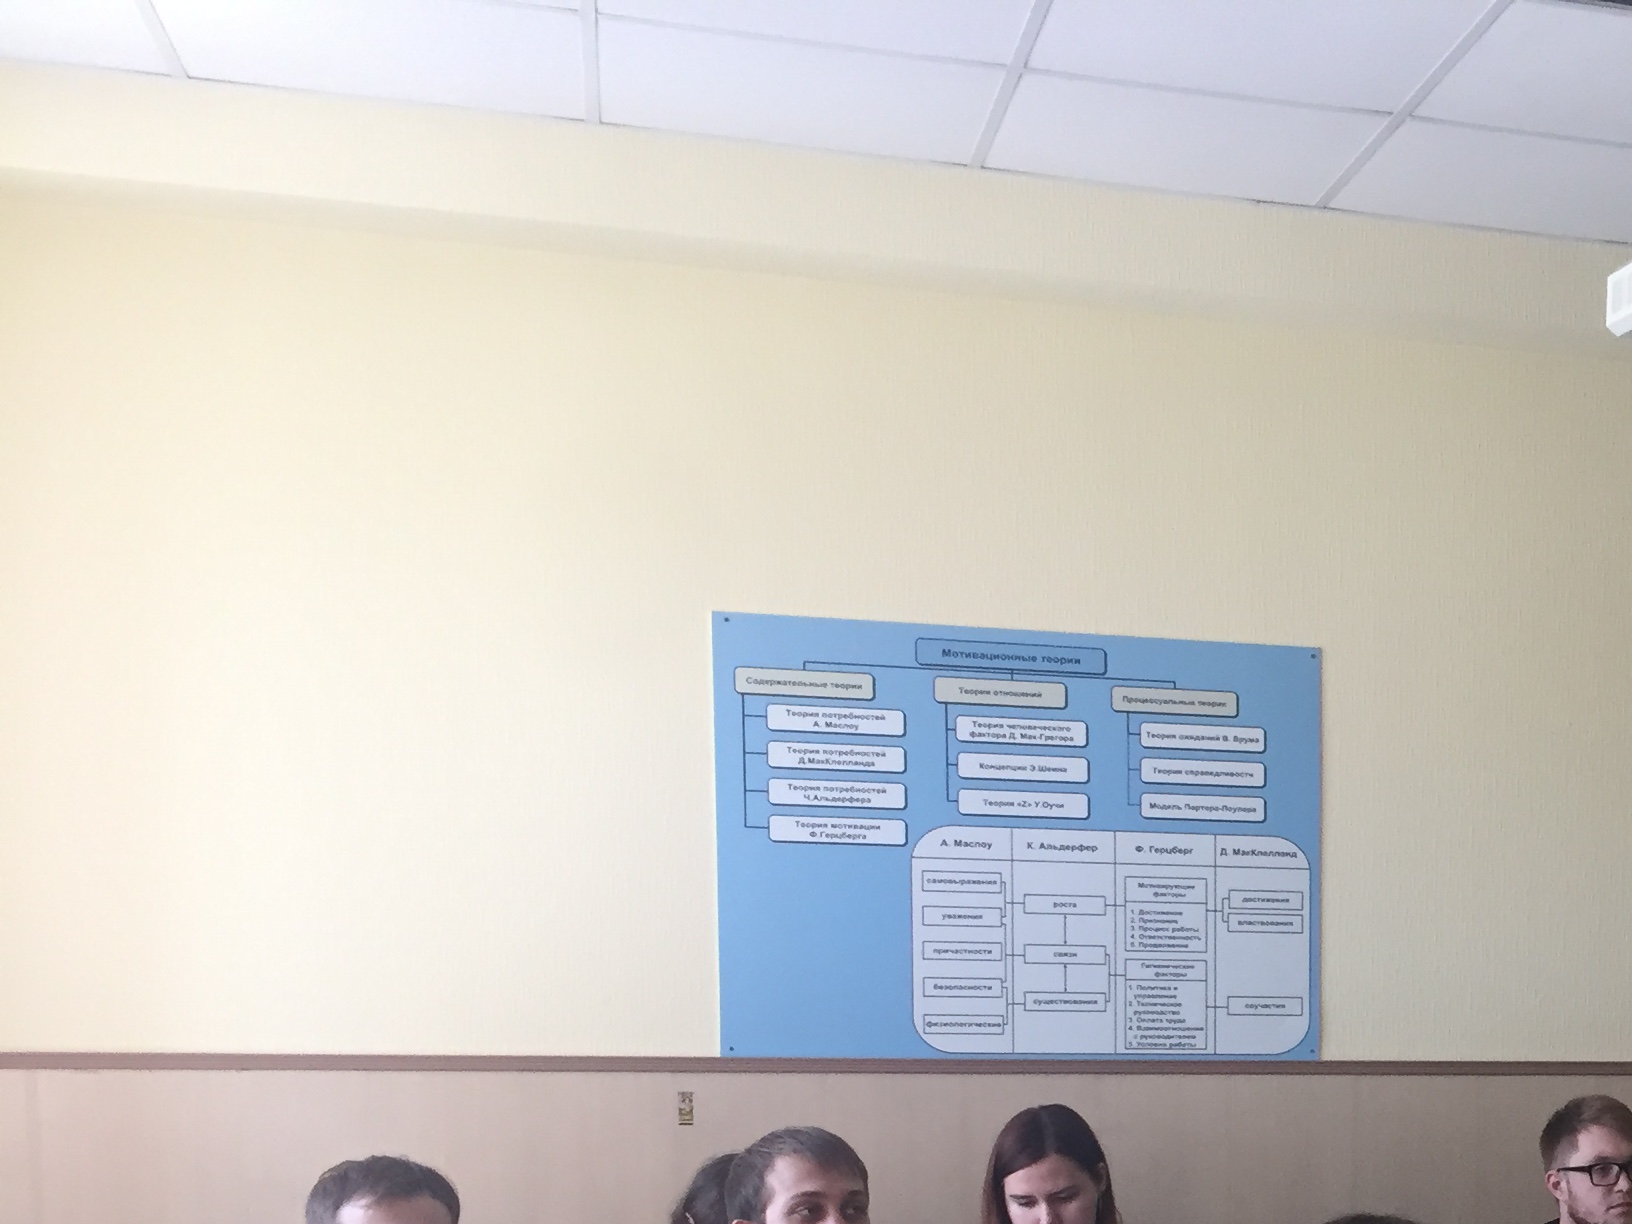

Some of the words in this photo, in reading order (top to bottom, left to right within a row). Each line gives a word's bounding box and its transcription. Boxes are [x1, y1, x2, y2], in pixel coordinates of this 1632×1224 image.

[942, 648, 1037, 664] Мотивационные
[1041, 655, 1081, 666] теории
[745, 676, 828, 689] Содержательные
[830, 682, 863, 692] теории
[993, 688, 1043, 699] отношений
[1122, 695, 1196, 707] Процессуальные
[786, 708, 820, 720] Теория
[822, 711, 886, 722] потребностей
[825, 721, 860, 731] Маслоу
[972, 720, 1005, 731] Теория
[1006, 723, 1072, 733] человеческого
[969, 730, 1007, 741] фактора
[1146, 731, 1177, 741] Теория
[787, 746, 820, 757] Теория
[822, 749, 886, 760] потребностей
[1153, 767, 1183, 777] Теория
[1184, 769, 1254, 779] справедливости
[788, 783, 821, 794] Теория
[823, 786, 887, 796] потребностей
[983, 798, 1015, 809] Теория
[1149, 803, 1182, 812] Модель
[795, 820, 828, 831] Теория
[830, 822, 881, 833] мотивации
[954, 839, 992, 850] Маслоу
[1039, 842, 1098, 853] Альдерфер
[1149, 846, 1194, 856] Герцберг
[1053, 901, 1077, 909] роста
